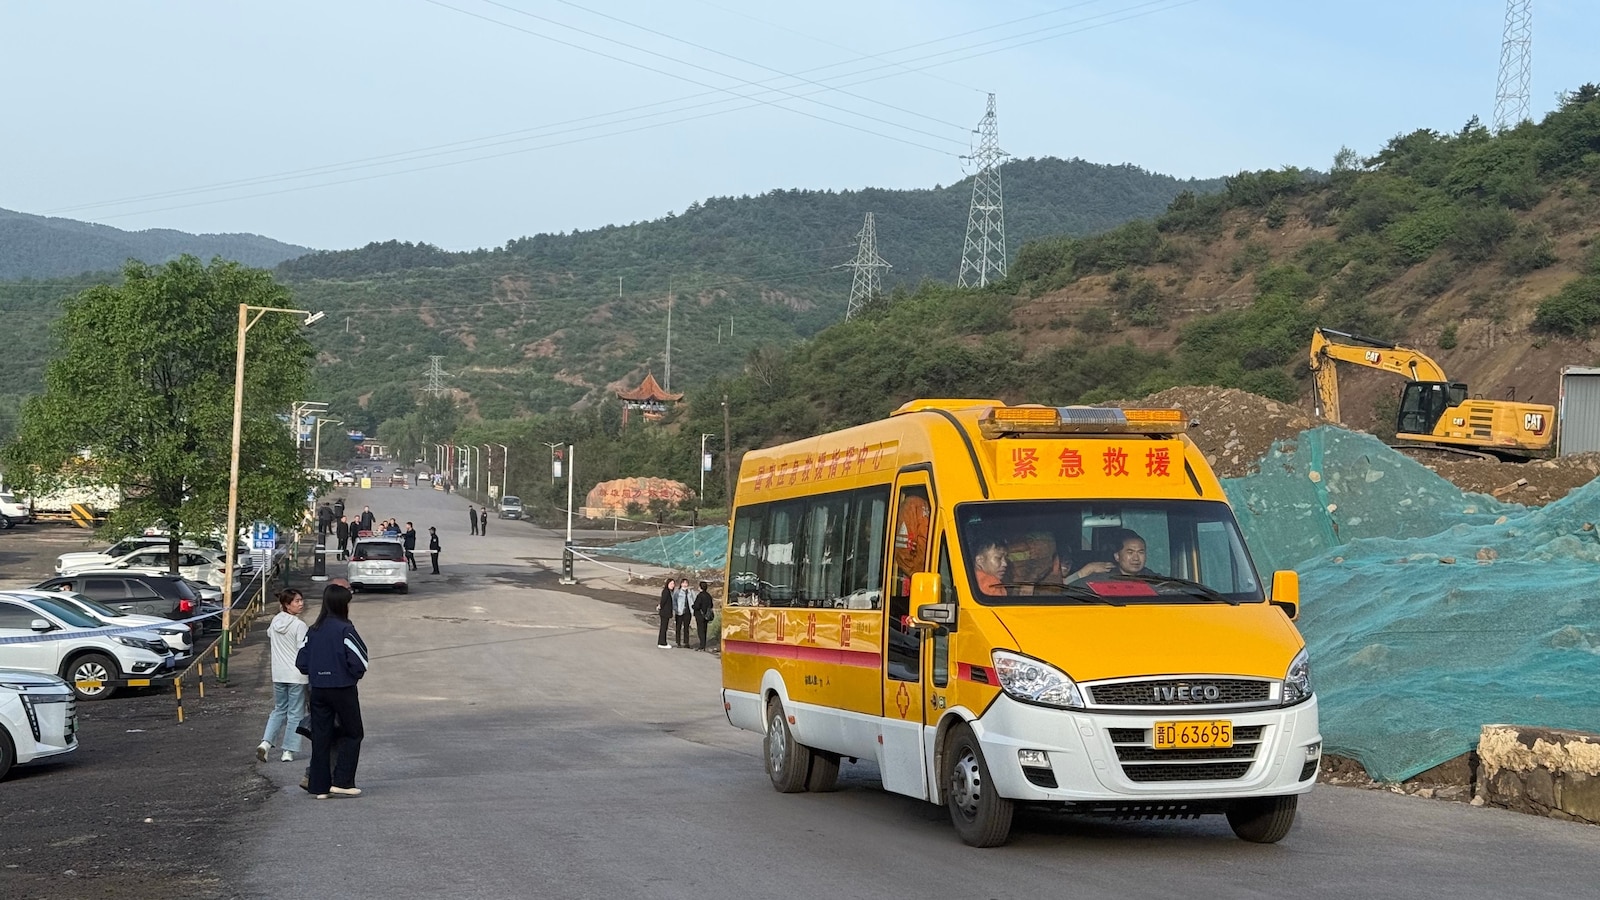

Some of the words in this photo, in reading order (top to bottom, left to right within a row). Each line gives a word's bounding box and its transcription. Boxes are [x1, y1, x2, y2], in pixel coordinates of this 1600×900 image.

[1365, 351, 1380, 362] CAT
[1453, 418, 1464, 426] CAT
[1524, 413, 1543, 431] CAT
[1012, 447, 1171, 479] 紧急救援
[258, 522, 270, 539] P
[1153, 685, 1220, 701] IVECO
